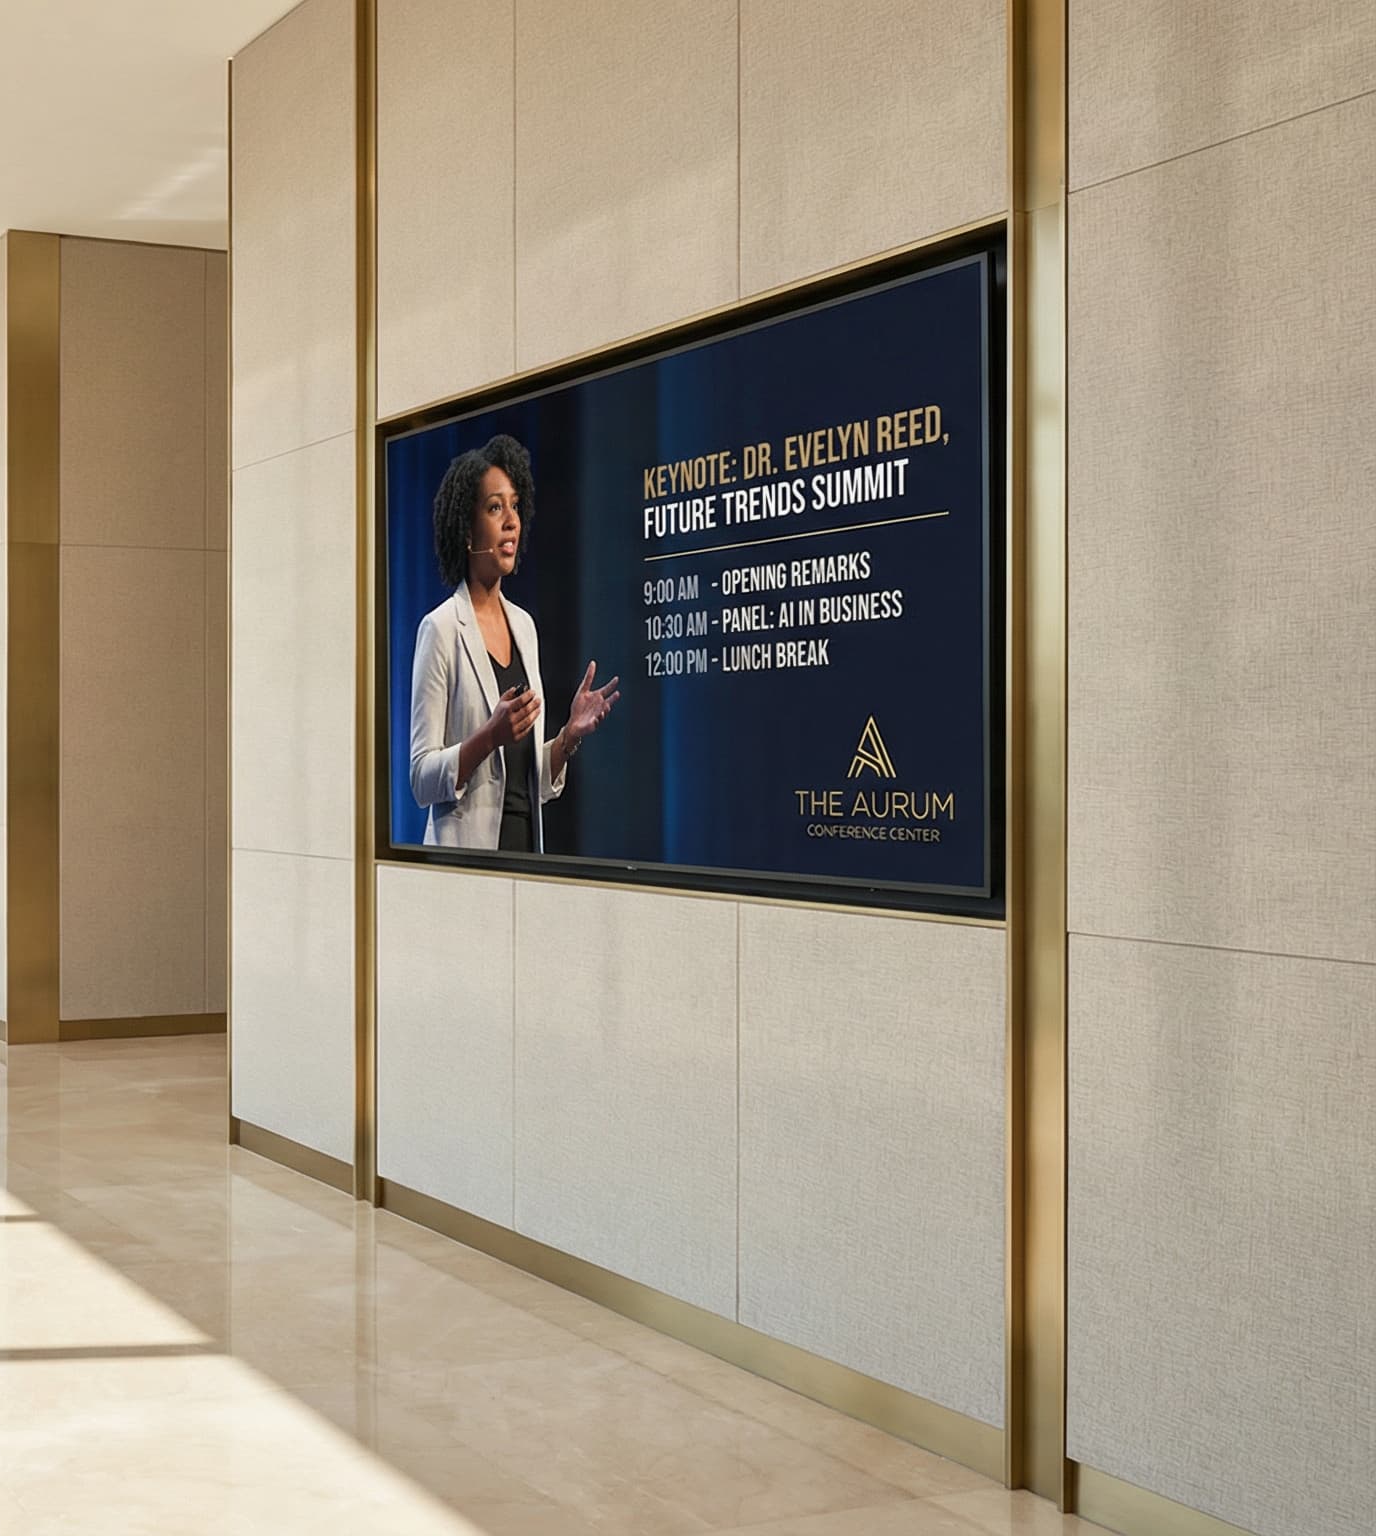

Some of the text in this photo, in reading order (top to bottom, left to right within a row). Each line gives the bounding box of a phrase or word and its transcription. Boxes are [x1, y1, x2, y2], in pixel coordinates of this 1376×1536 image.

[644, 405, 950, 499] KEYNOTE: DR. EVELYN REED,
[644, 459, 909, 539] FUTURE TRENDS SUMMIT
[644, 578, 674, 605] 9:00
[678, 575, 698, 600] AM
[722, 564, 786, 595] OPENING
[791, 552, 871, 585] REMARKS
[645, 614, 682, 640] 10:30
[686, 611, 707, 636] AM
[722, 606, 774, 633] PANEL:
[778, 601, 794, 628] AI
[799, 599, 814, 626] IN
[819, 590, 903, 624] BUSINESS
[645, 651, 682, 677] 12:00
[686, 649, 707, 673] PM
[723, 644, 771, 672] LUNCH
[776, 639, 829, 668] BREAK
[795, 791, 954, 820] THE AURUM
[807, 824, 940, 842] CONFERENCE CENTER
